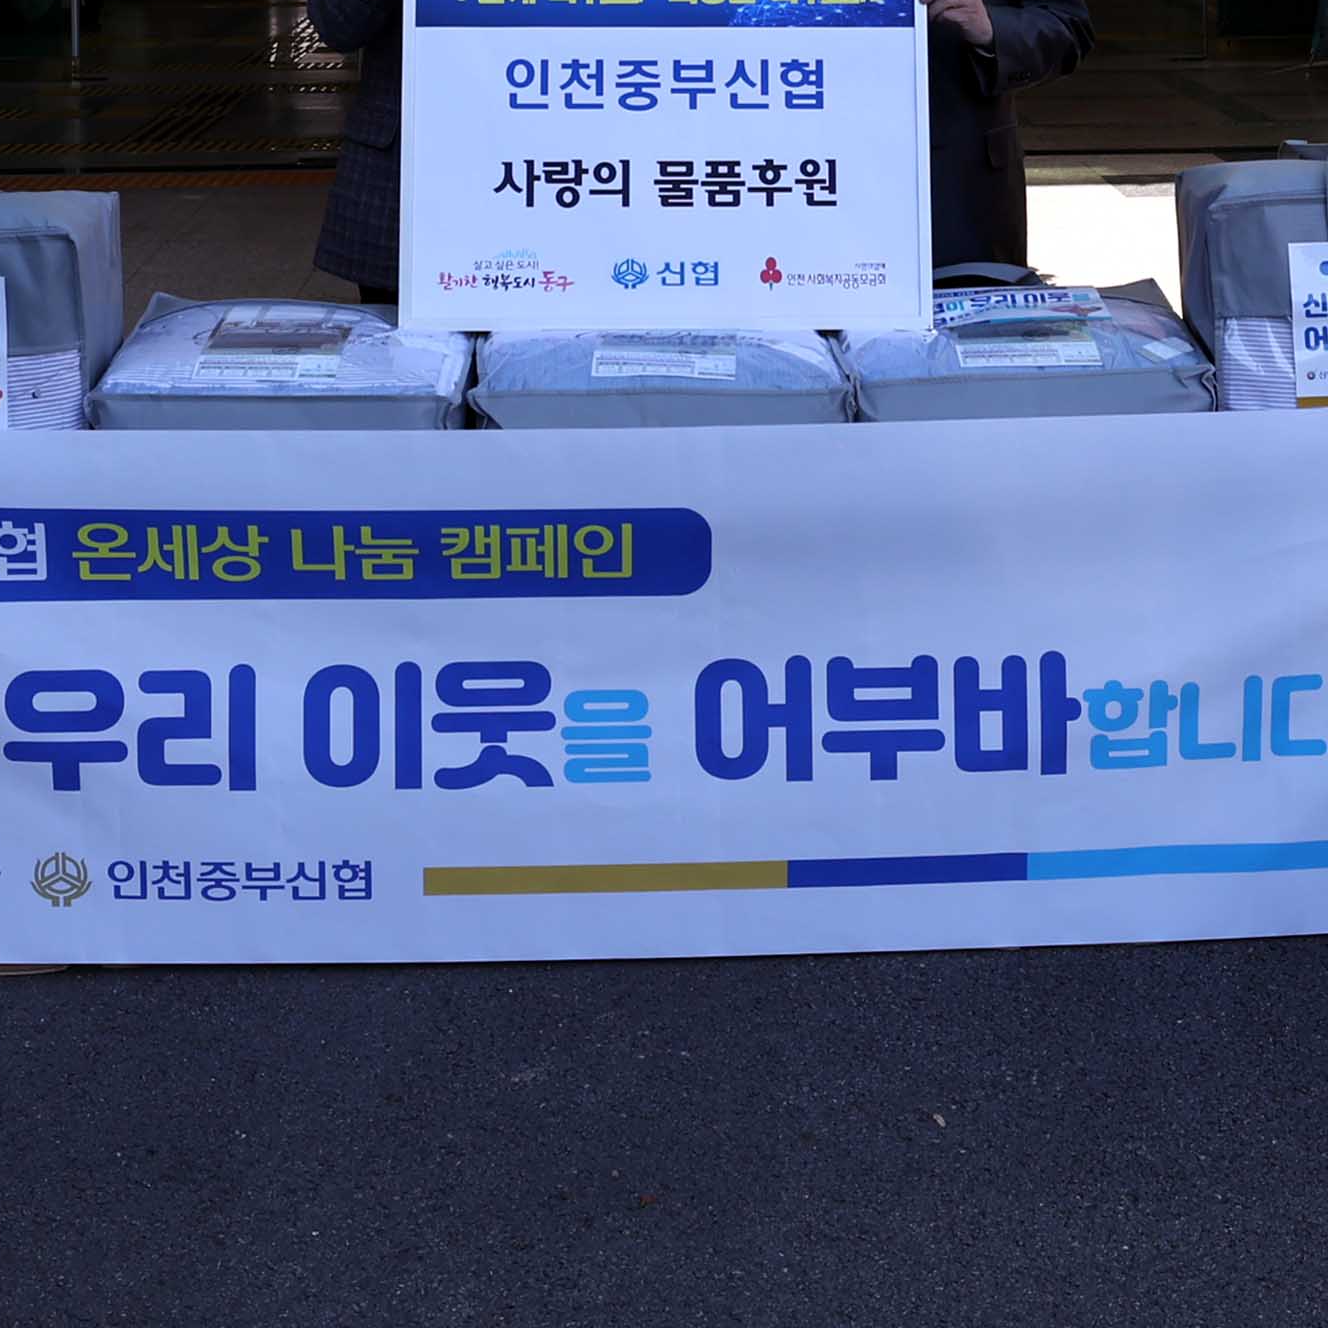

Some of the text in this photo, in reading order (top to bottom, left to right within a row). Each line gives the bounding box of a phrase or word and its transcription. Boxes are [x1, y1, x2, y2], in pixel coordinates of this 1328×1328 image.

[505, 58, 826, 111] 인천중부신협
[493, 158, 839, 208] 사랑의 물품후원
[482, 273, 536, 292] 행복도시
[538, 270, 575, 293] 동구
[656, 259, 720, 288] 신협
[72, 522, 270, 583] 온세상
[290, 525, 420, 582] 나눔
[441, 522, 634, 581] 캠페인
[2, 662, 257, 792] 우리
[302, 660, 653, 791] 이웃을
[107, 859, 374, 902] 인천중부신협
